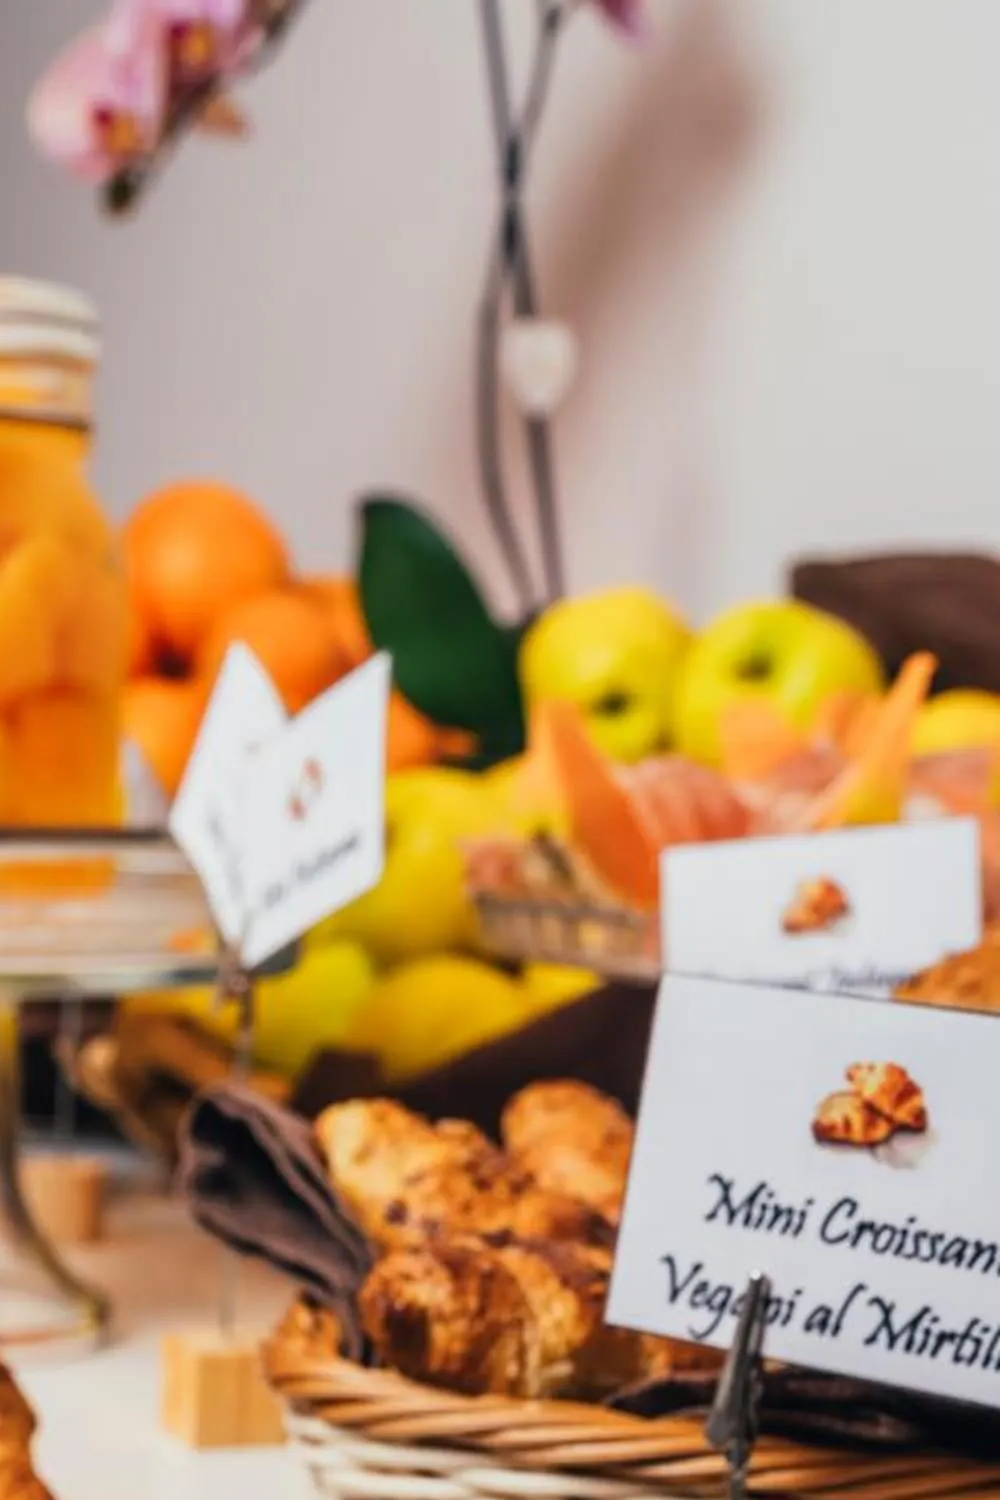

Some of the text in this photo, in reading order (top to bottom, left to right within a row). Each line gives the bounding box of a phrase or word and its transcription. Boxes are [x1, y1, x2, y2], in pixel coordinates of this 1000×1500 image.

[704, 1173, 1000, 1277] Mini Croissan
[803, 1284, 867, 1338] al
[863, 1295, 1000, 1373] Mirtil
